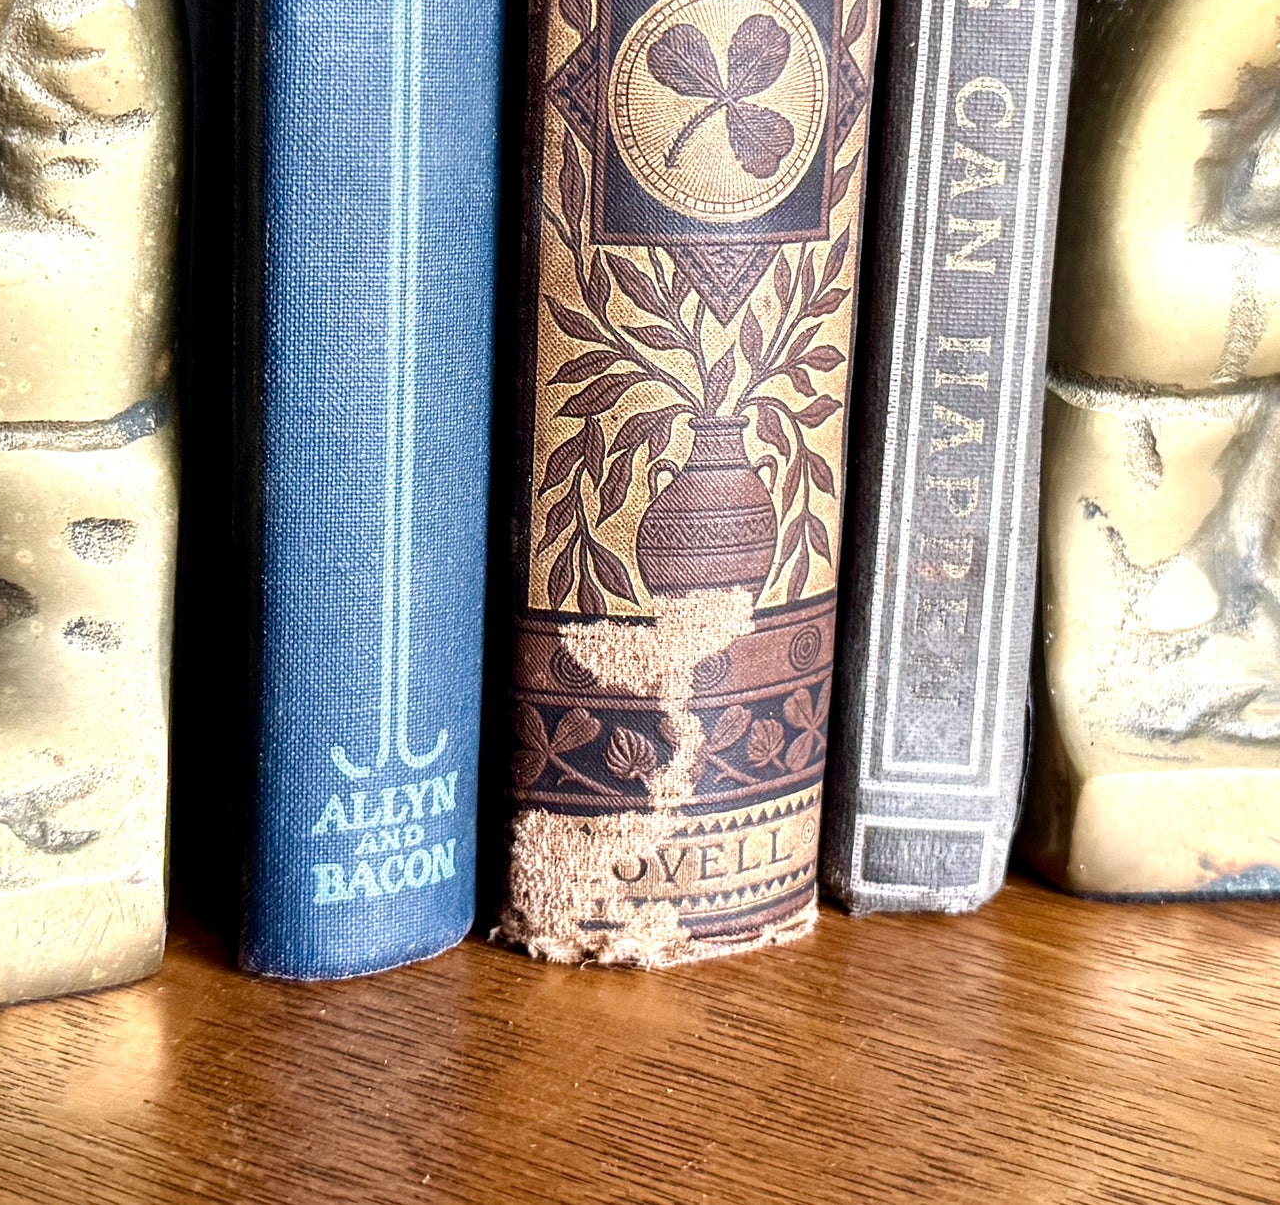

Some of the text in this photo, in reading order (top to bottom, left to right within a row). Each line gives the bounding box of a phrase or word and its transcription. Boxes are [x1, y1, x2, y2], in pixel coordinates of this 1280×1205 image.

[945, 76, 1014, 275] CAN
[311, 770, 458, 835] ALLYN
[311, 837, 457, 905] BACON
[355, 824, 425, 855] AND
